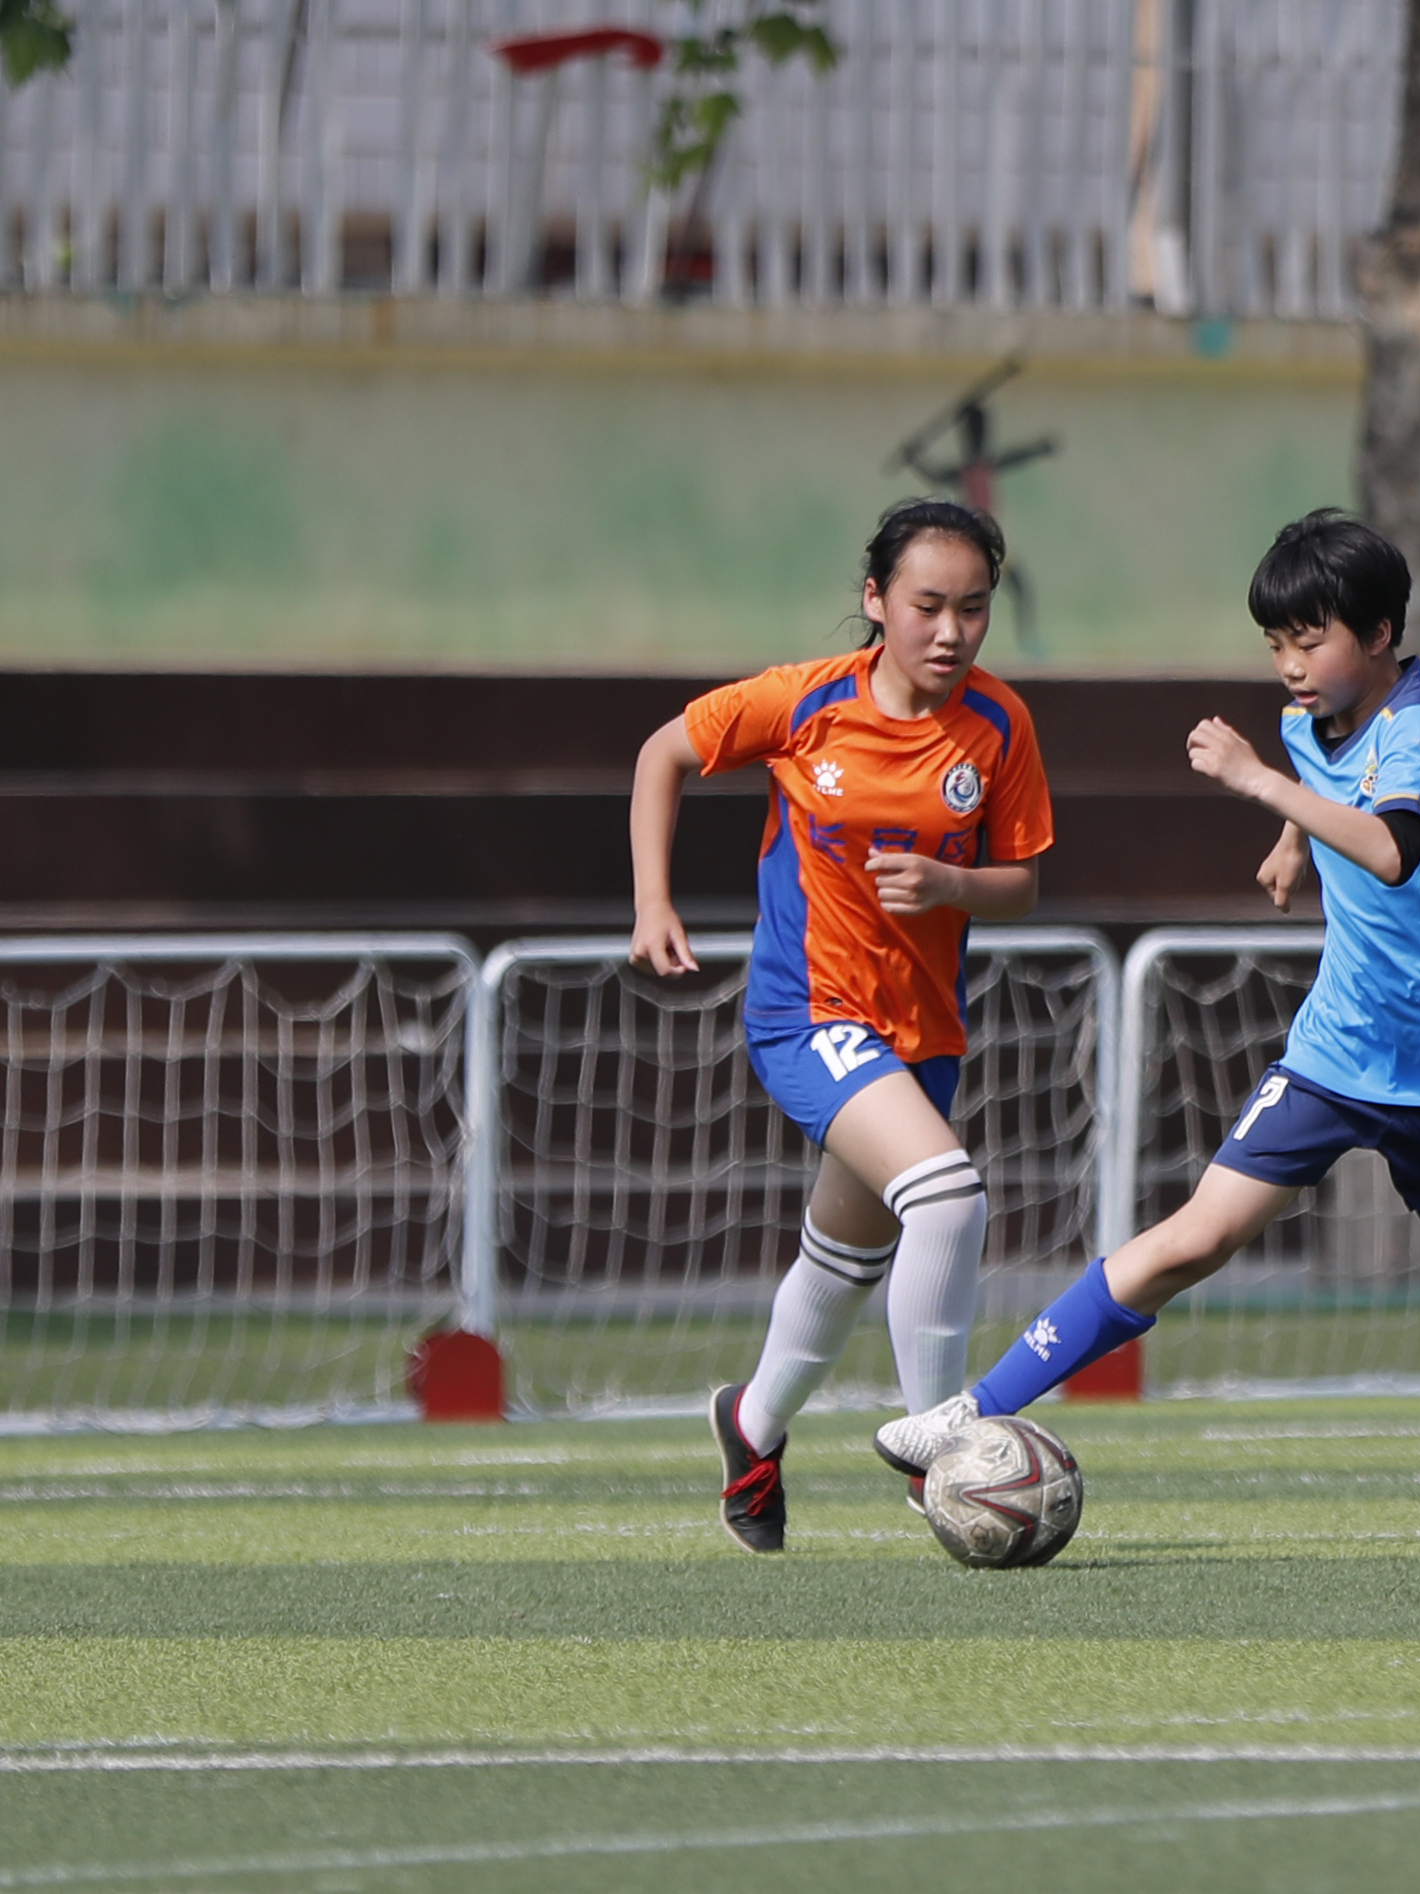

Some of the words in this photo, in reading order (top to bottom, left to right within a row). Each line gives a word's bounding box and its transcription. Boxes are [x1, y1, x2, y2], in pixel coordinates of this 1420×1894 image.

[811, 783, 845, 798] LME
[809, 1023, 881, 1083] 12
[1233, 1075, 1290, 1141] 7
